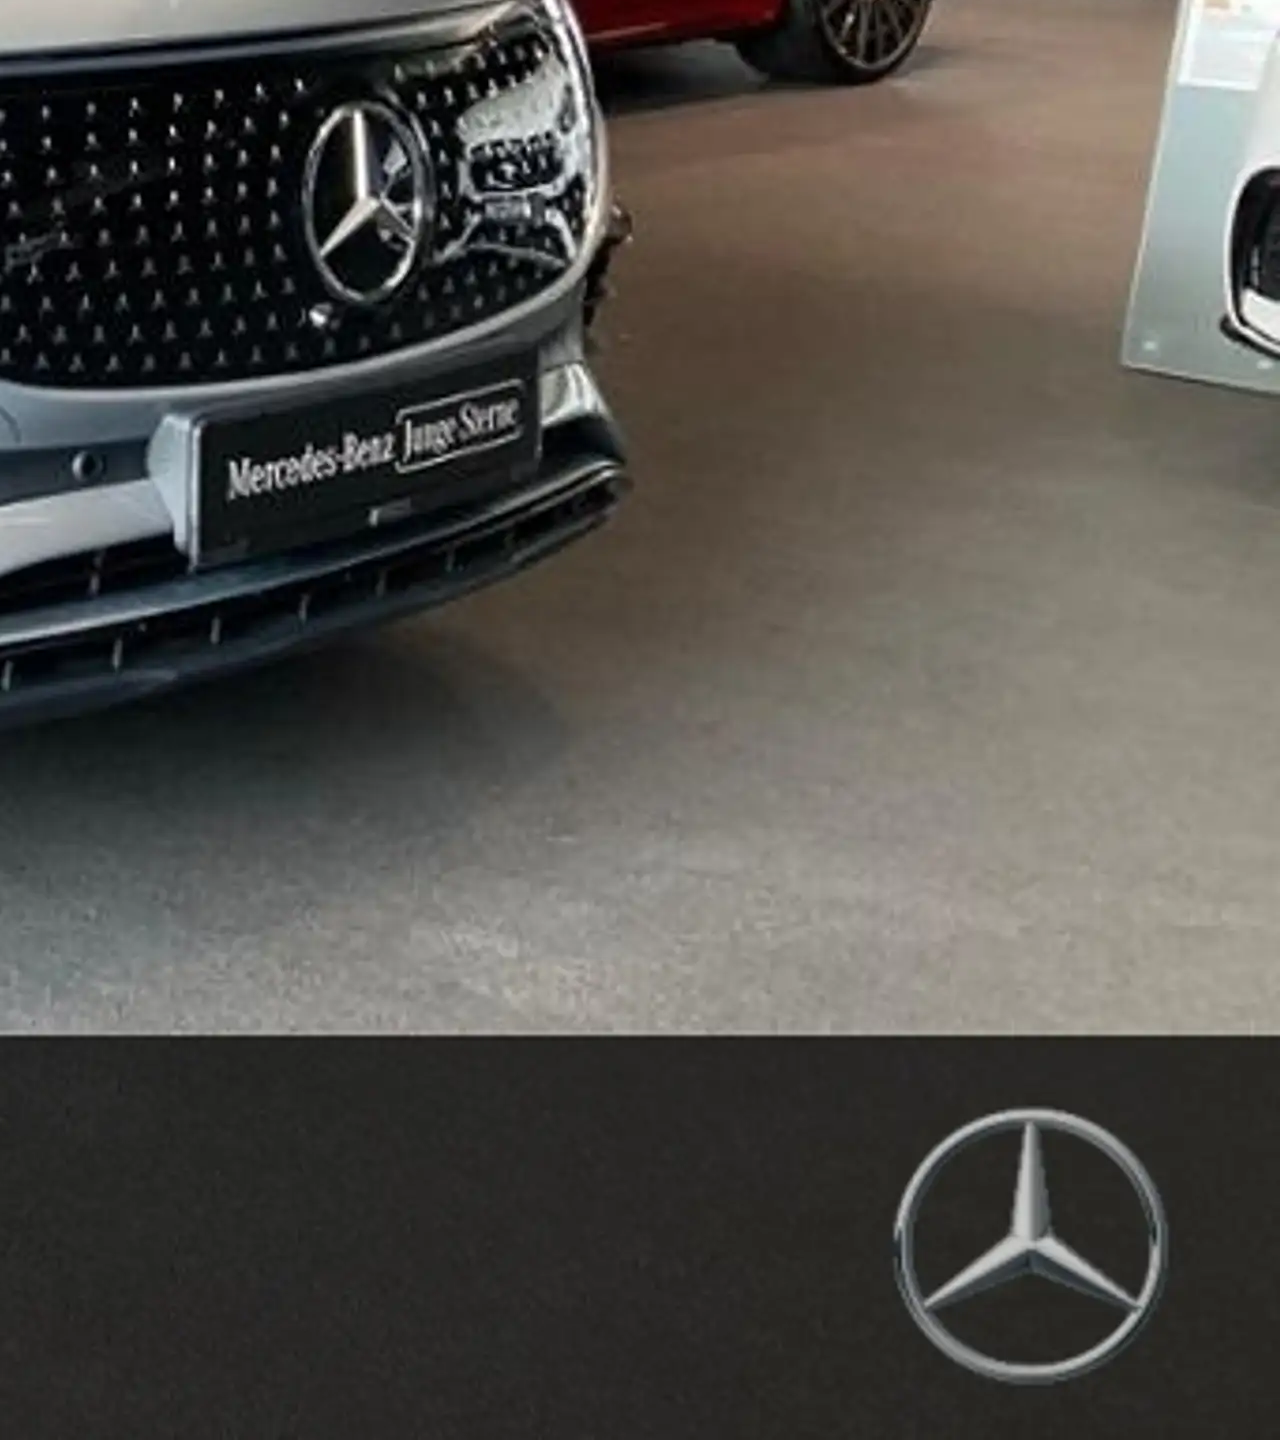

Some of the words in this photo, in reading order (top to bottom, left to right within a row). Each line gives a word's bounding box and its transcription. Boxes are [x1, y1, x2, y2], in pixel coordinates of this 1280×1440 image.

[228, 433, 394, 499] Mercedes-Benz
[403, 417, 458, 462] Junge
[459, 399, 519, 440] Sterne
